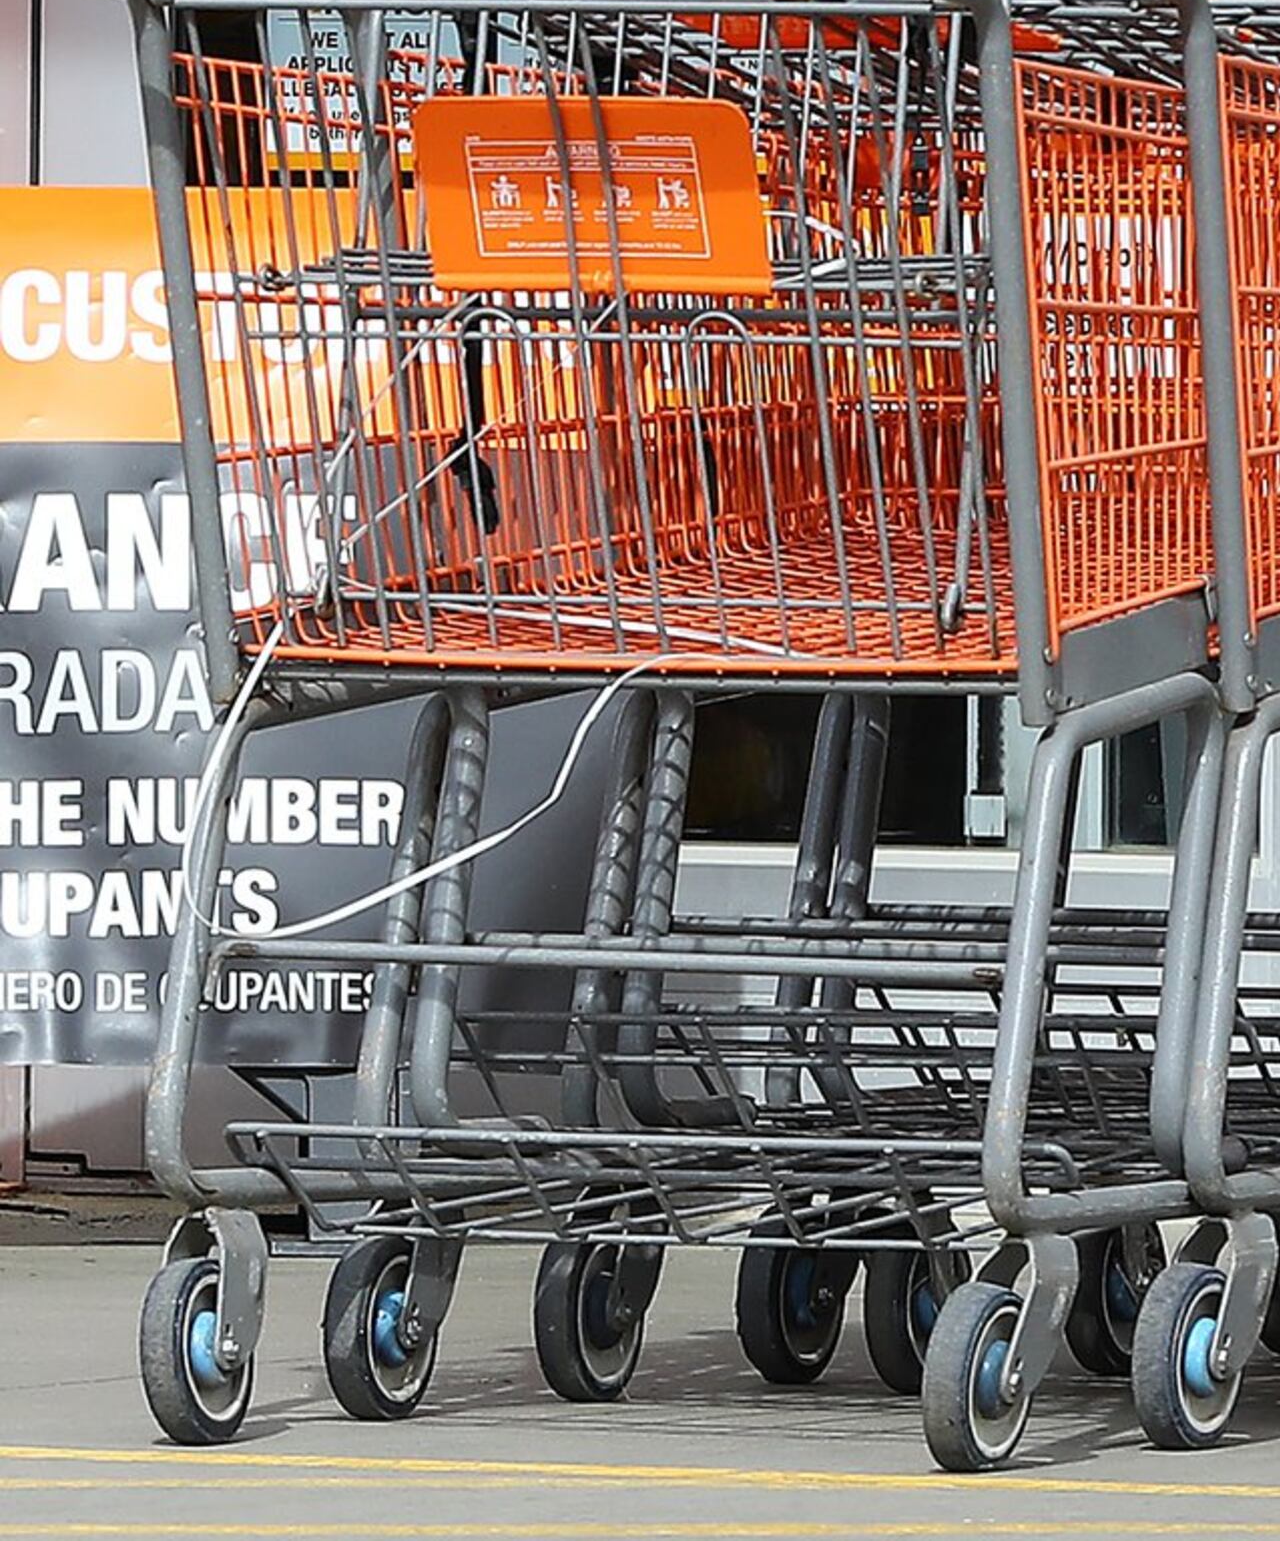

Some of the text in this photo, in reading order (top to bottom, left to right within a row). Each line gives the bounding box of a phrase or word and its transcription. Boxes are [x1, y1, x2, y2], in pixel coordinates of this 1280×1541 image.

[107, 777, 404, 847] NUMBER
[0, 970, 84, 1013] ERO
[95, 971, 148, 1013] DE
